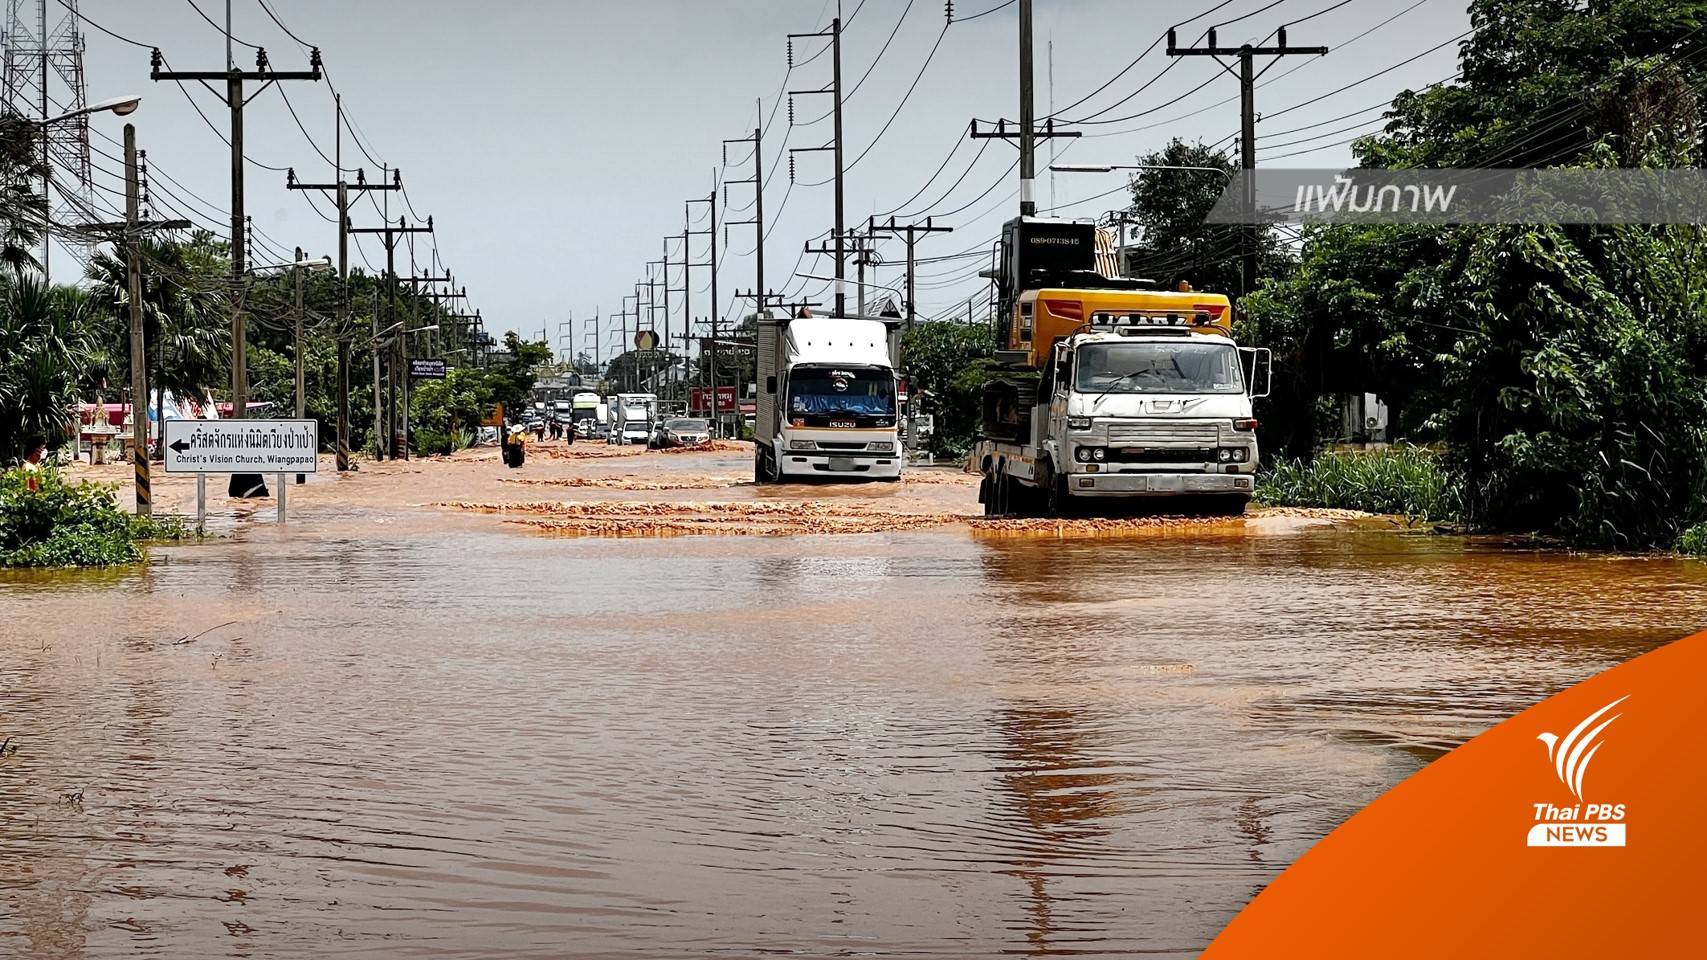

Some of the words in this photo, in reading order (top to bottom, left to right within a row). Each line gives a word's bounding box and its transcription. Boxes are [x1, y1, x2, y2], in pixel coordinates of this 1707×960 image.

[190, 425, 314, 449] คริสตจักรแห่งนิมิตเวียงป่าเป้า
[176, 454, 207, 463] Christ's
[209, 454, 233, 463] Vision
[235, 454, 265, 464] Church,
[267, 454, 314, 466] Wiangpapao
